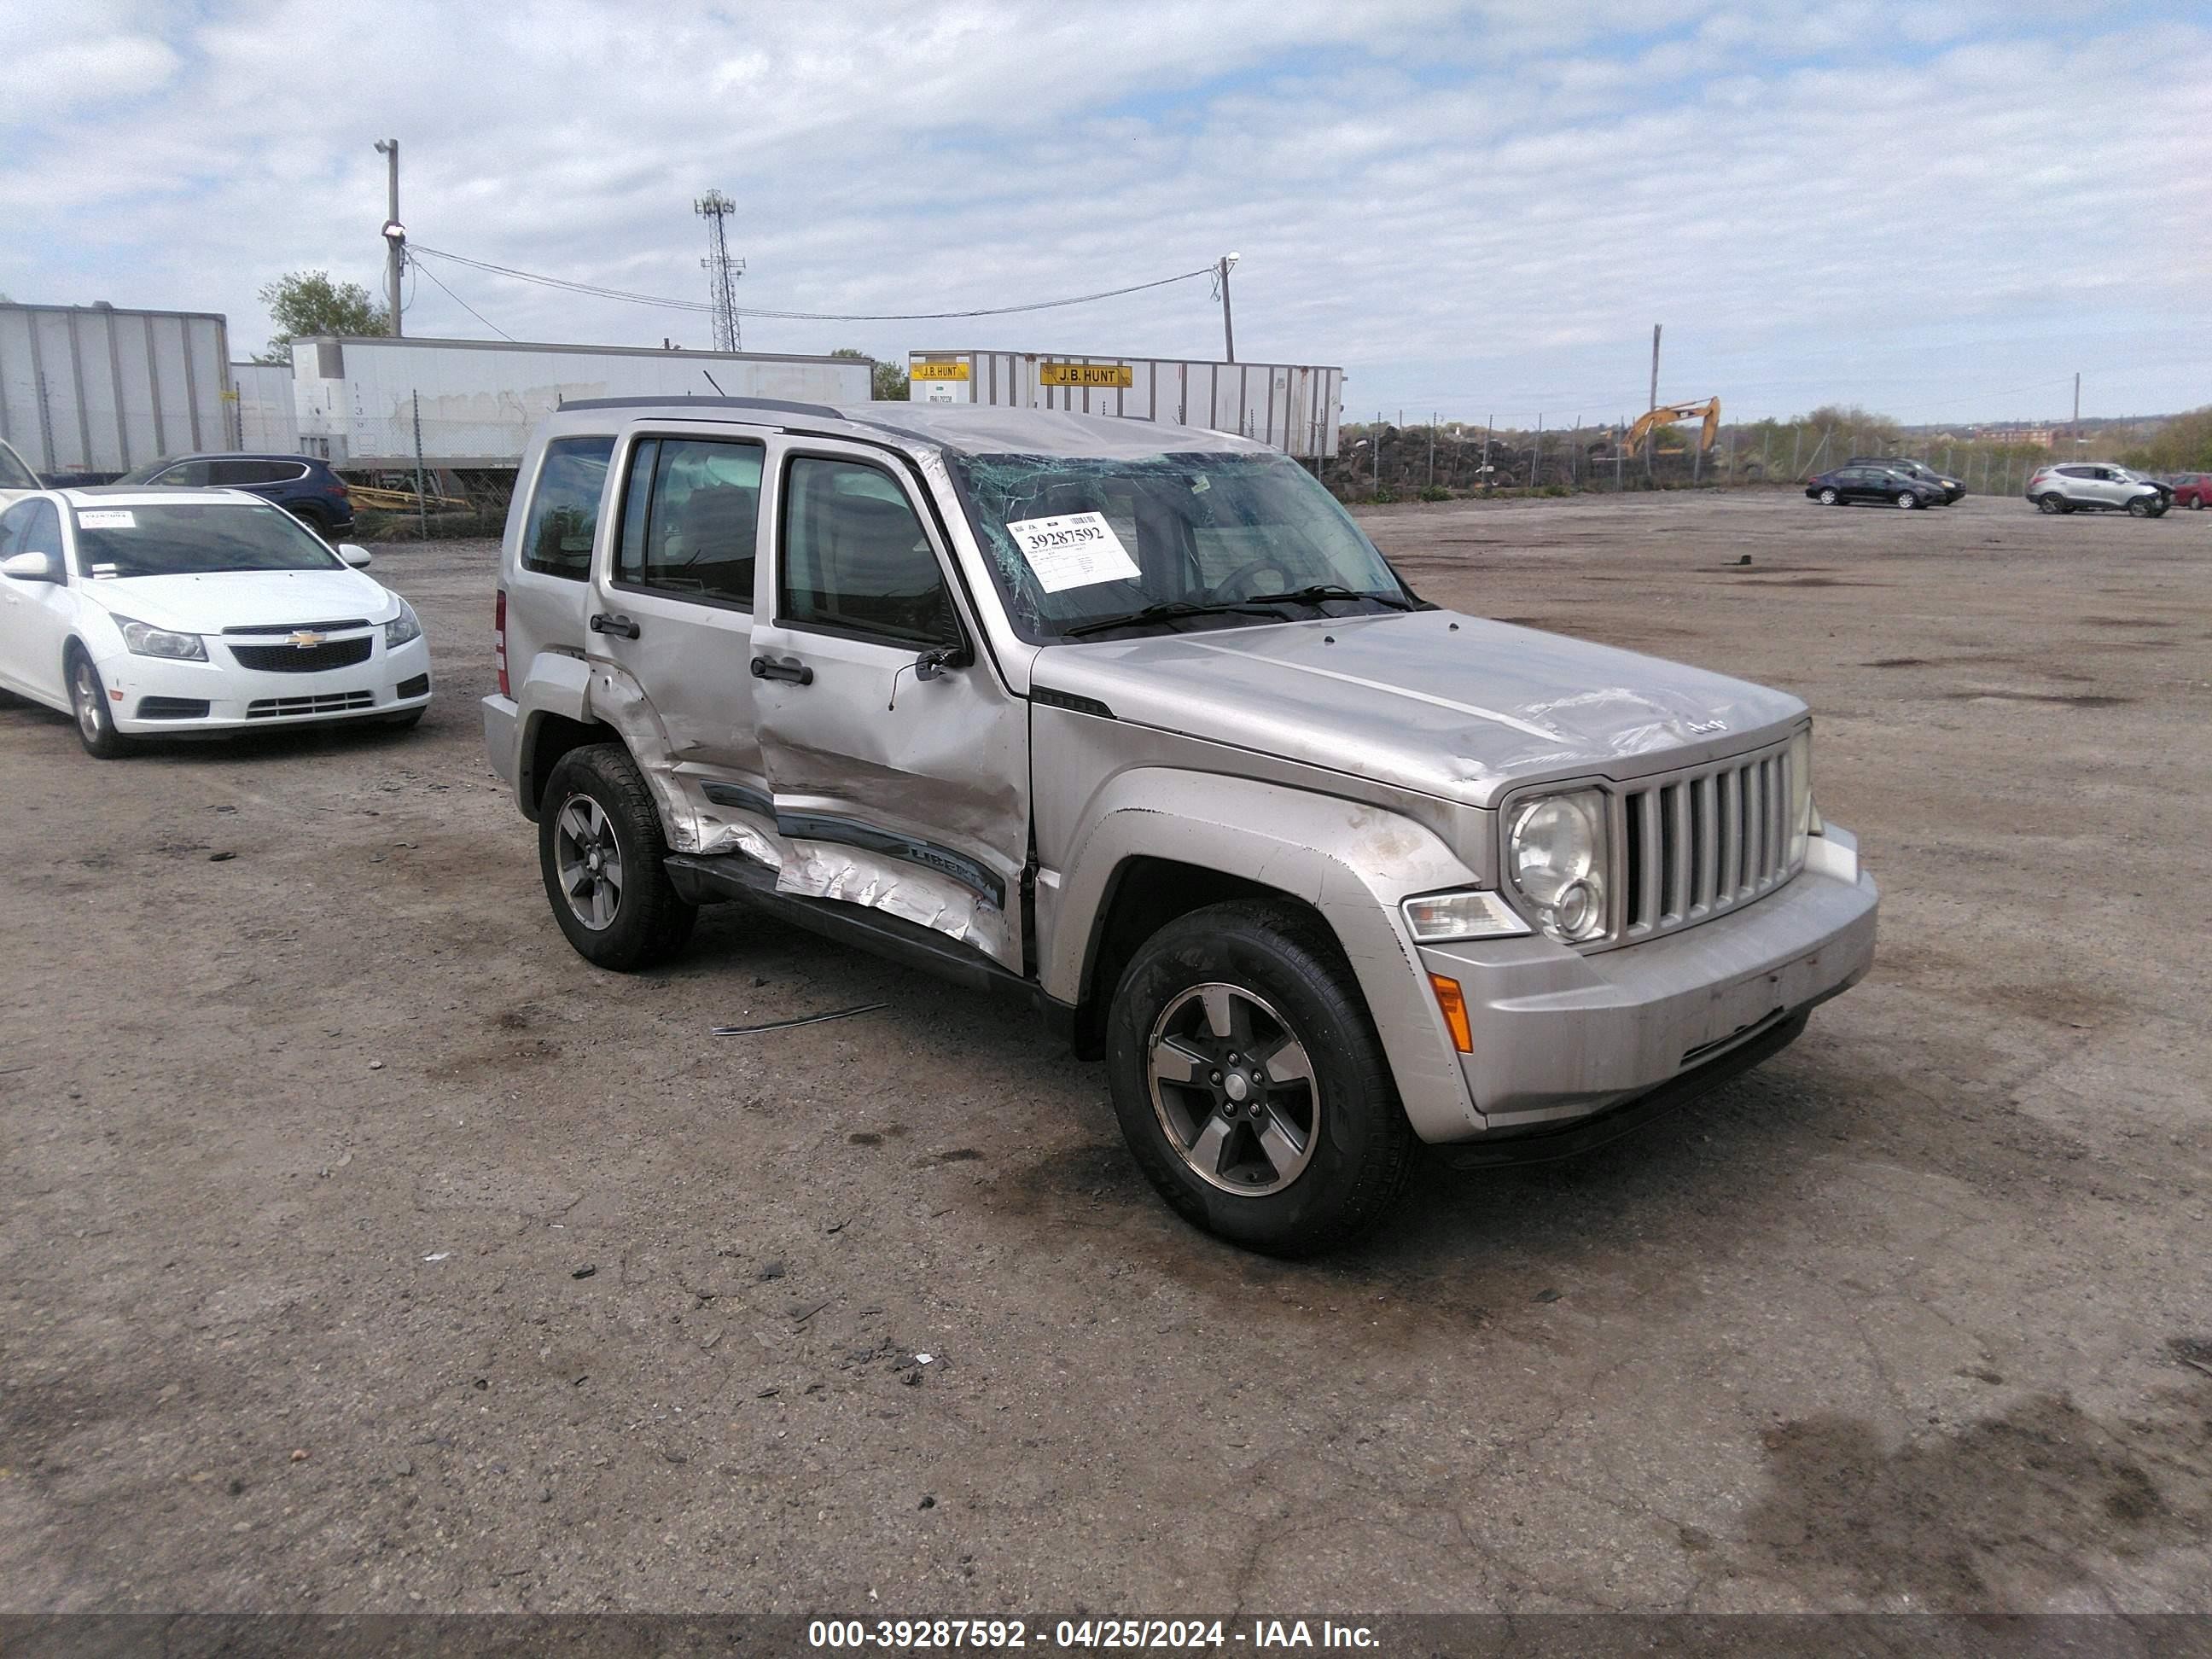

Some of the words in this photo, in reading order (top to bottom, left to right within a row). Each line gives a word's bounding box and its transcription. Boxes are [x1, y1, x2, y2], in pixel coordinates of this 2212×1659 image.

[923, 366, 937, 376] J.B.
[938, 366, 957, 376] HUNT
[1060, 369, 1081, 381] J.B.
[1084, 370, 1115, 382] HUNT
[1027, 527, 1104, 550] 39287592
